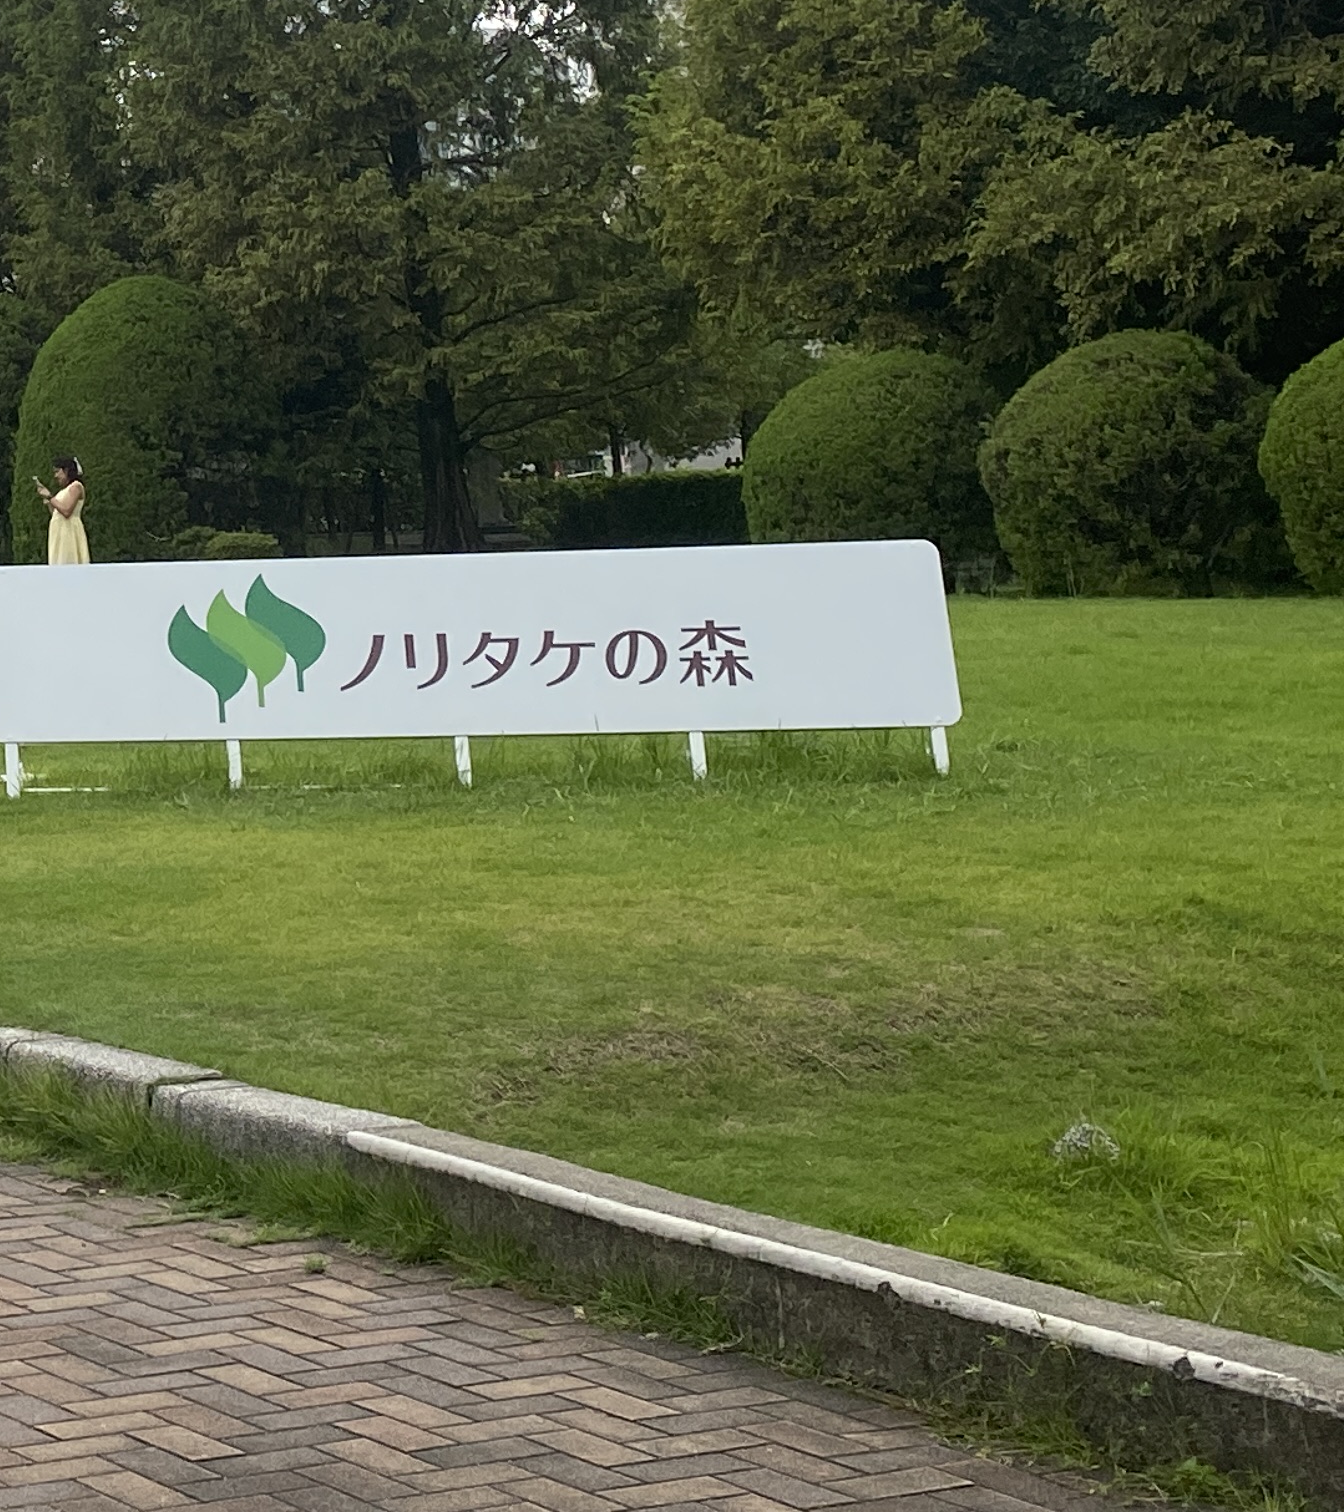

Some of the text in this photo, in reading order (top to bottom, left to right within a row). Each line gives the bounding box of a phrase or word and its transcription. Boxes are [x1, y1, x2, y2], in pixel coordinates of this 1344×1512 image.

[340, 619, 754, 691] ノリタケの森
